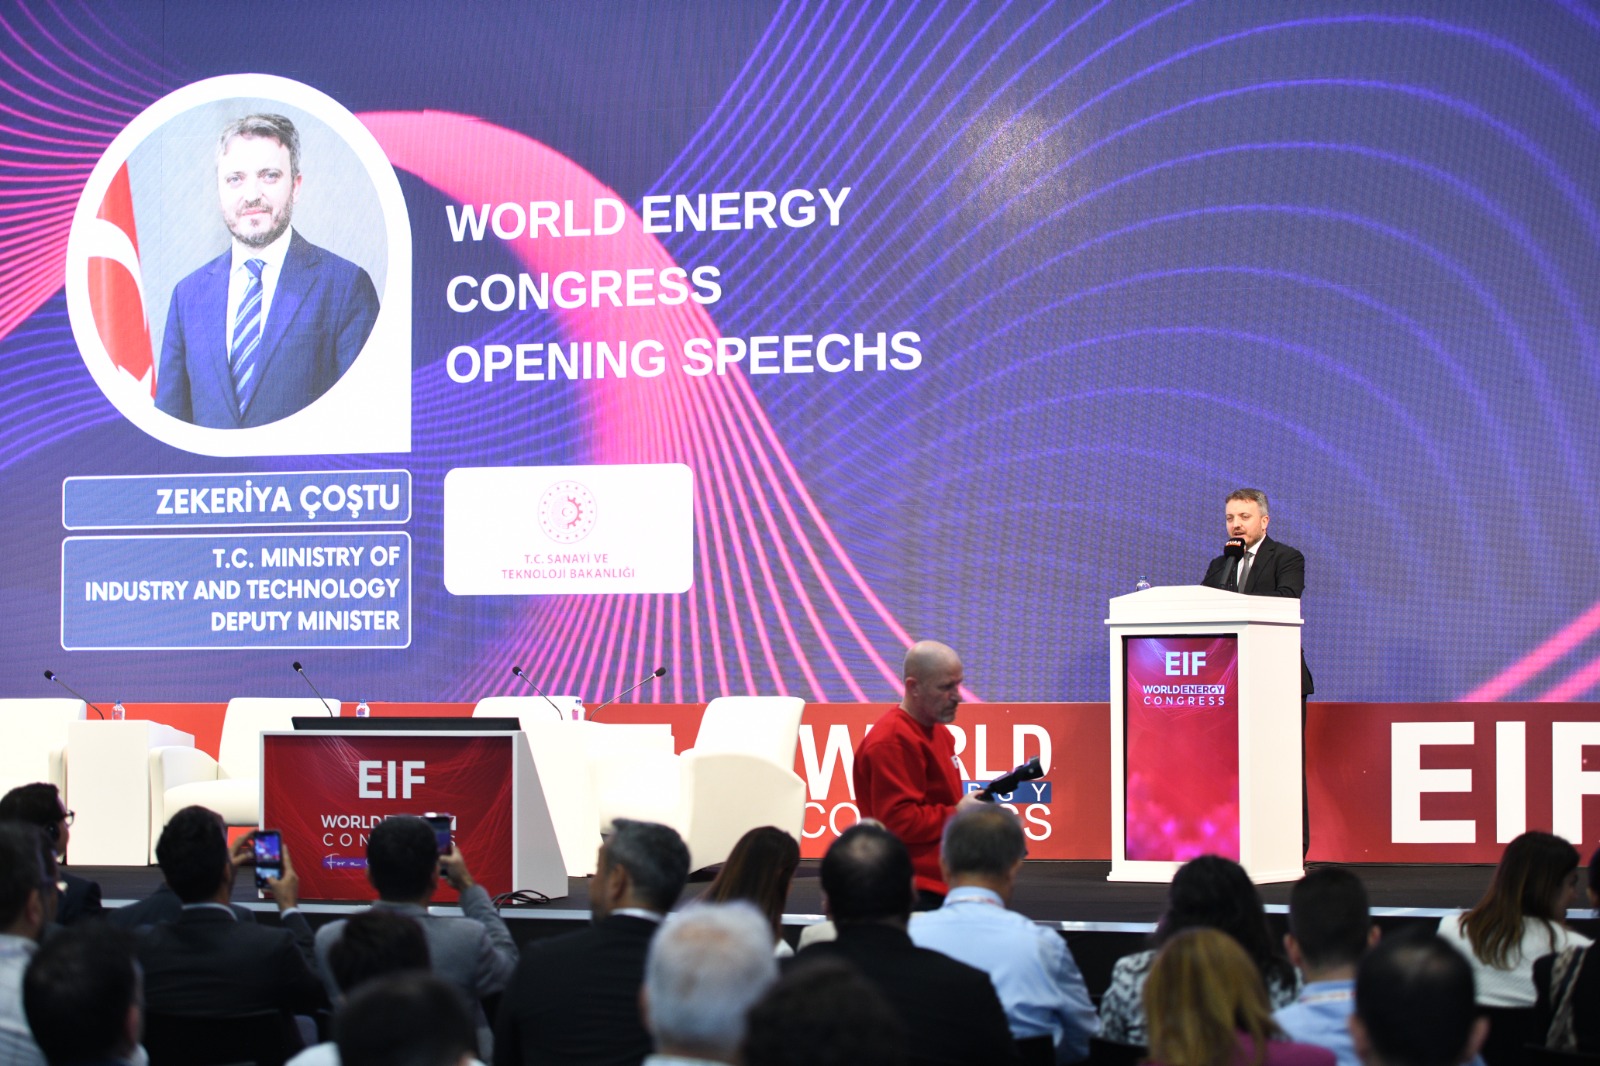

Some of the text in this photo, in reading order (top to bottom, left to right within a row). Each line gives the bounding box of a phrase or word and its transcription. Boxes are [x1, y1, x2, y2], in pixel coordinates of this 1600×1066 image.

[445, 187, 851, 242] WORLD ENERGY
[446, 266, 722, 313] CONGRESS
[445, 331, 923, 384] OPENING SPEECHS
[156, 480, 400, 519] ZEKERİYA ÇOŞTU
[213, 546, 400, 568] T.C. MINISTRY OF
[524, 552, 609, 564] T.C. SANAYİ VE
[501, 566, 635, 579] TEKNOLOJİ BAKANLIĞI
[85, 578, 400, 601] INDUSTRY AND TECHNOLOGY
[211, 609, 400, 632] DEPUTY MINISTER
[1165, 651, 1206, 676] EIF
[1143, 685, 1224, 694] WORLD ENERGY
[1143, 696, 1225, 706] CONGRESS
[799, 724, 1052, 800] WRLD
[358, 760, 426, 799] EIF
[1391, 721, 1600, 844] EIF
[321, 815, 382, 829] WORLD
